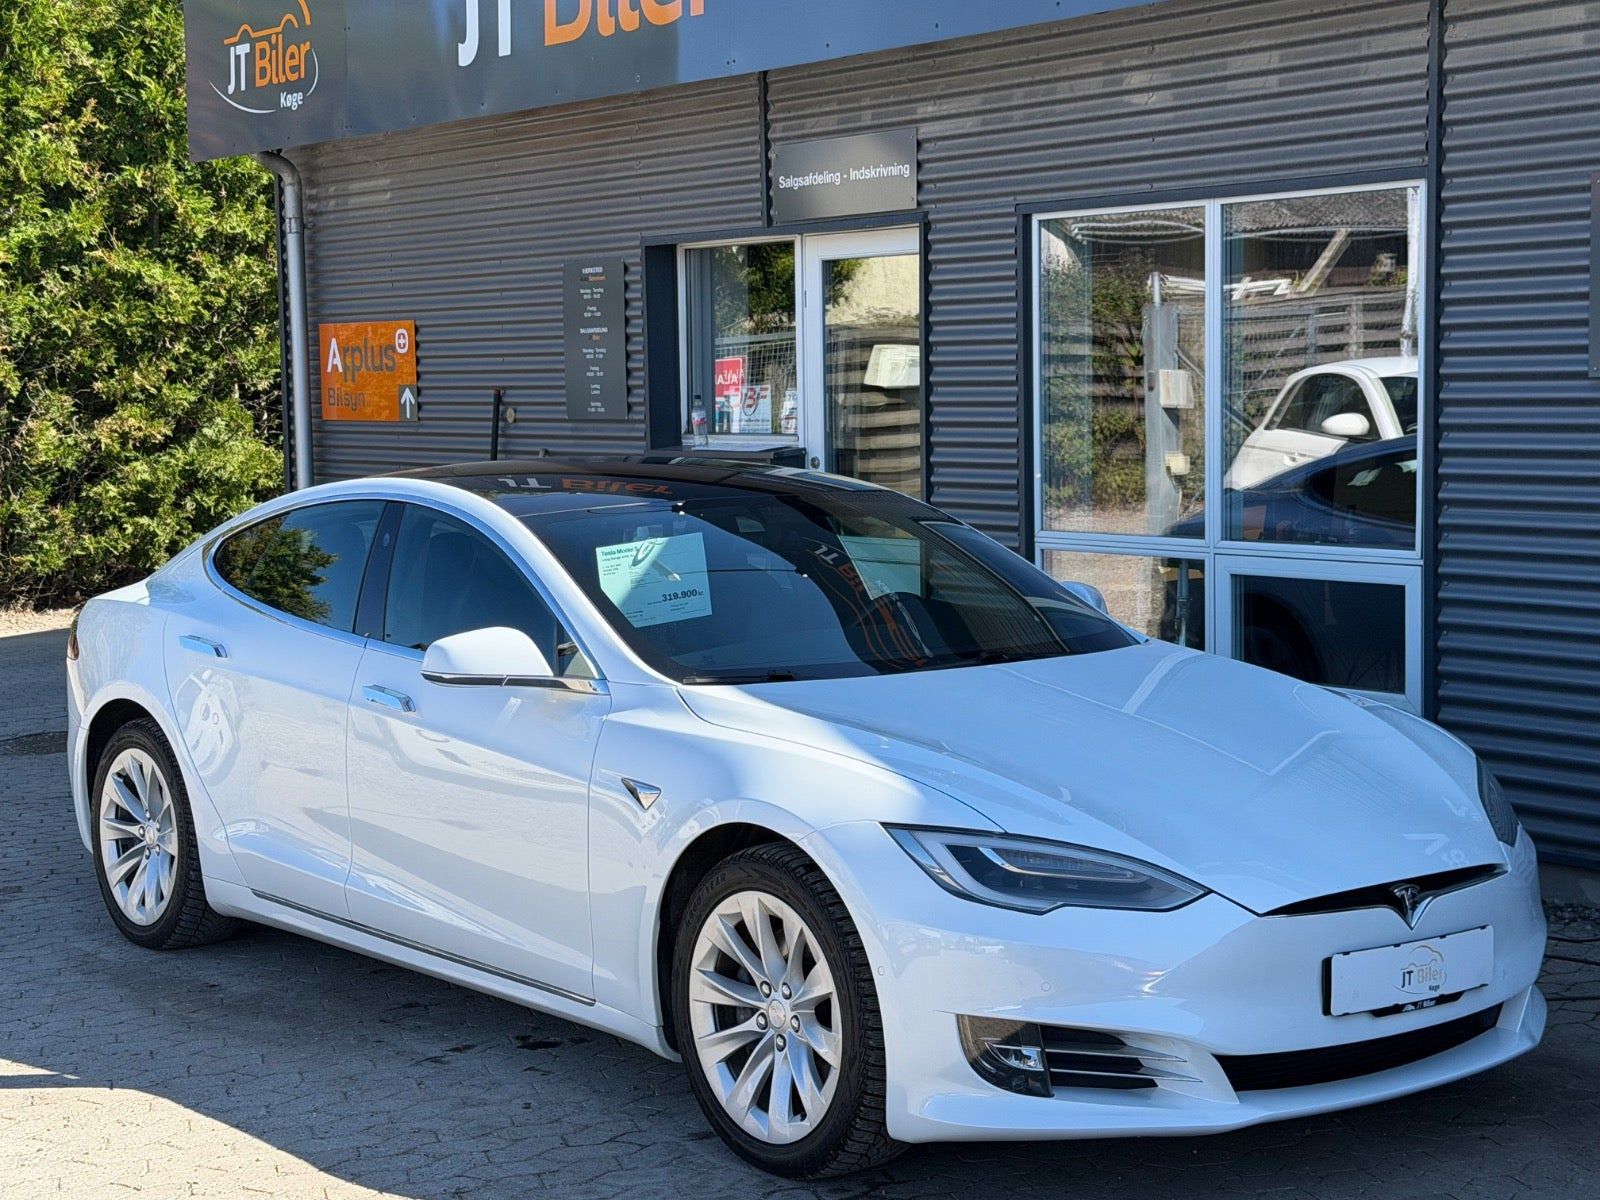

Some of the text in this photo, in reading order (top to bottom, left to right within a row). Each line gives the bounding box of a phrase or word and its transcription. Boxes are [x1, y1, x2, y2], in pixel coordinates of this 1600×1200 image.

[228, 33, 310, 94] JT Biler
[281, 92, 303, 110] Køge
[779, 171, 841, 190] Salgsafdeling
[850, 163, 910, 181] Indskrivning
[328, 387, 366, 411] Bilsyn
[662, 589, 698, 602] 319.900
[1401, 966, 1443, 988] JT Biler
